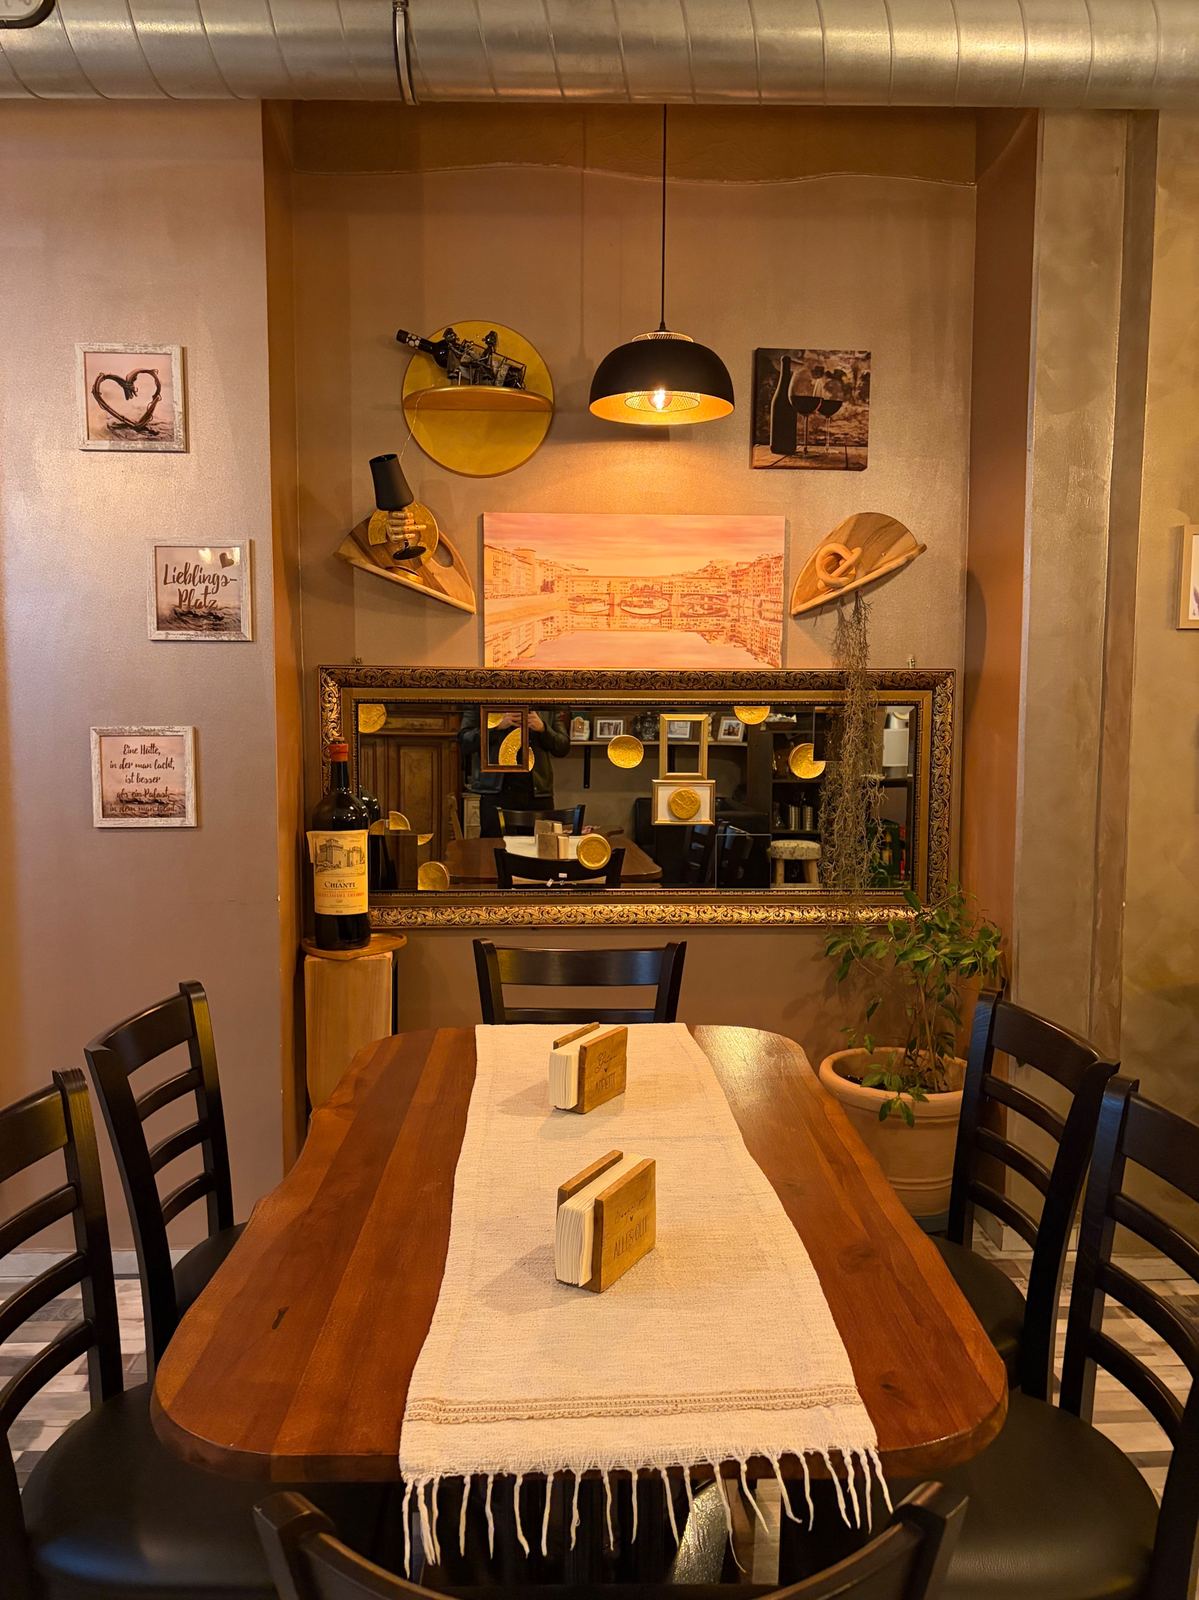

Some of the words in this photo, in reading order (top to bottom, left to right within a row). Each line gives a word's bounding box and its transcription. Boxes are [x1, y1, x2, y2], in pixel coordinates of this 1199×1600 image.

[163, 562, 237, 595] Lieblings-
[177, 585, 218, 610] Platz
[123, 744, 138, 755] Eine
[109, 760, 117, 769] in
[118, 757, 133, 770] der
[125, 772, 134, 784] ist
[136, 773, 161, 784] besser
